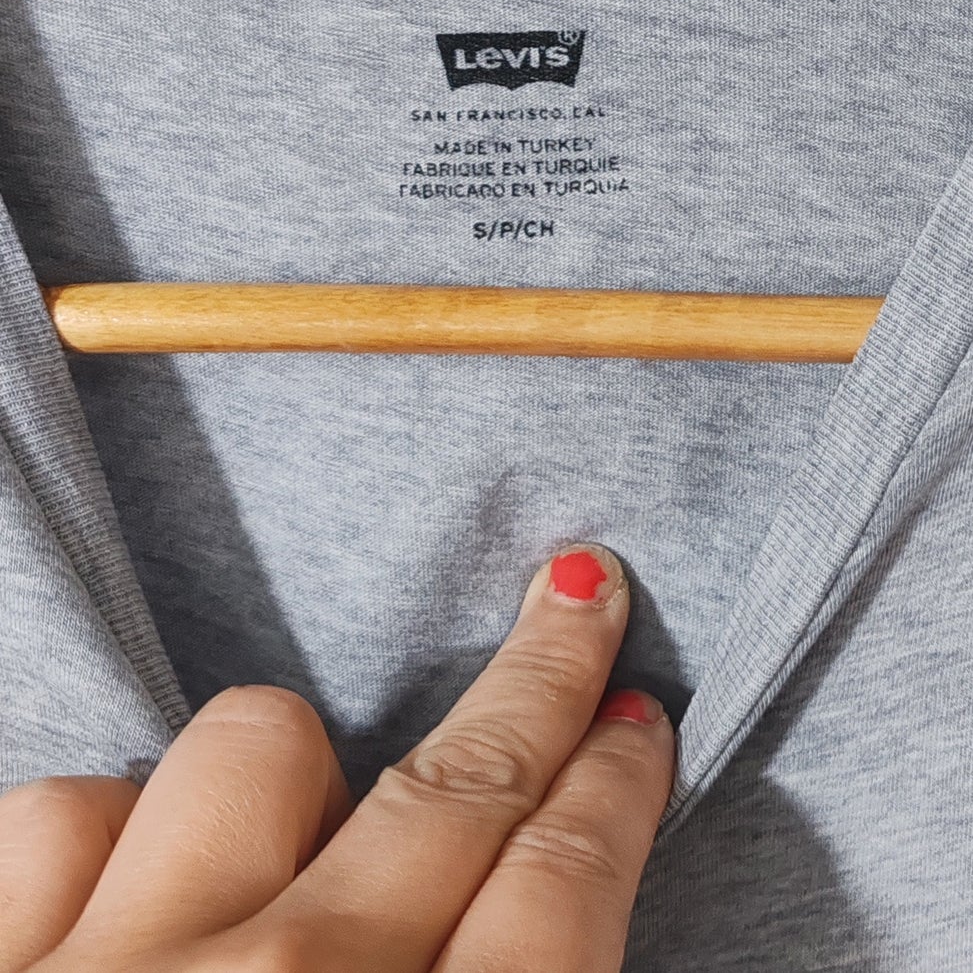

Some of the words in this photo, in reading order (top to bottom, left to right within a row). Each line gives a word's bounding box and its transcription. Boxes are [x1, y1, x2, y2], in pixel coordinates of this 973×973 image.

[411, 109, 447, 122] SAN
[434, 141, 488, 155] MADE
[494, 141, 512, 154] IN
[517, 137, 597, 154] TURKEY
[502, 162, 526, 177] EN
[535, 156, 621, 175] TURQUIE
[511, 183, 536, 198] EN
[473, 220, 555, 241] S/P/CH
